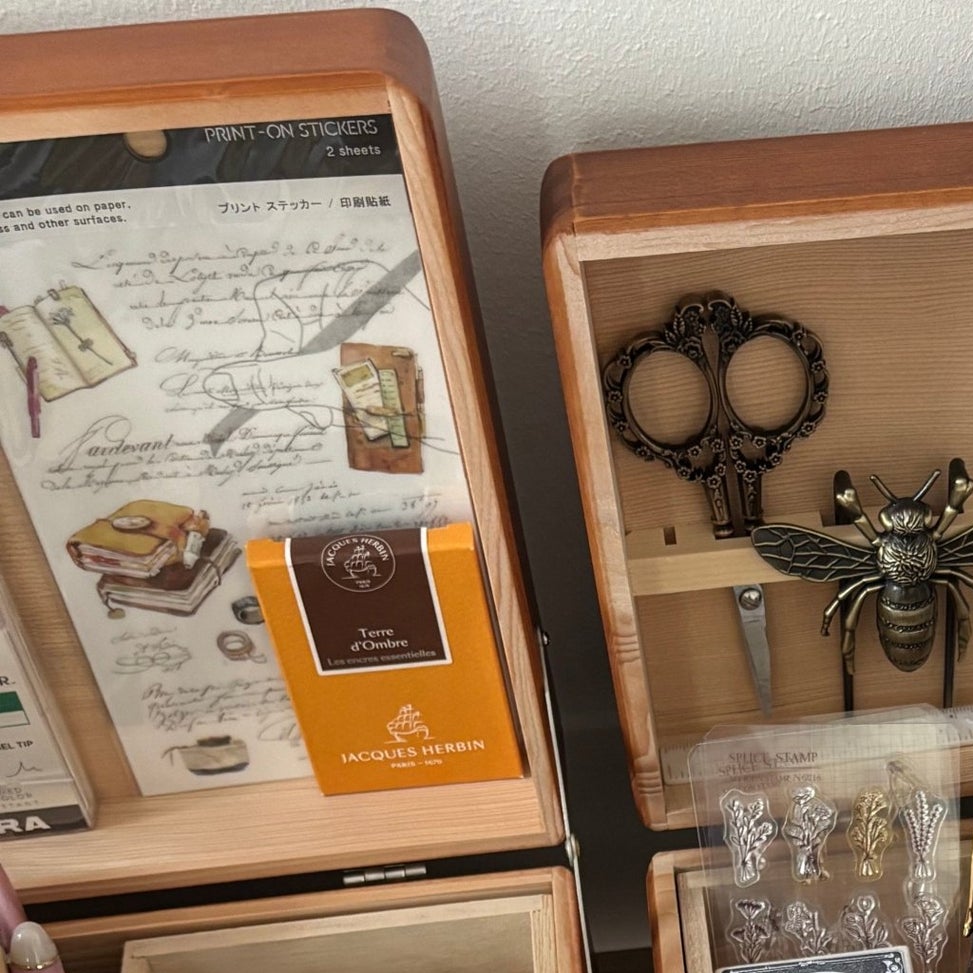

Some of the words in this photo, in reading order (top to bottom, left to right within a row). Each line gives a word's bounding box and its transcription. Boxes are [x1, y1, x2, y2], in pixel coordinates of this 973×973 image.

[204, 123, 295, 143] PRINT-ON
[298, 119, 379, 138] STICKERS
[326, 146, 336, 157] 2
[339, 145, 382, 157] sheets
[2, 210, 22, 220] can
[27, 207, 41, 217] be
[45, 204, 73, 216] used
[76, 204, 91, 213] on
[94, 200, 132, 216] paper.
[267, 199, 322, 212] ステッカー
[14, 221, 35, 232] and
[38, 217, 70, 229] other
[74, 214, 127, 227] surfaces.
[326, 538, 359, 567] JACQUES
[360, 537, 390, 562] HERBIN
[358, 628, 394, 639] Terre
[350, 639, 409, 652] d'Ombre
[327, 657, 345, 667] Les
[347, 655, 379, 665] encres
[380, 649, 437, 661] essentielles
[341, 747, 418, 765] JACQUES
[422, 739, 486, 756] HERBIN
[775, 751, 818, 763] STAMP
